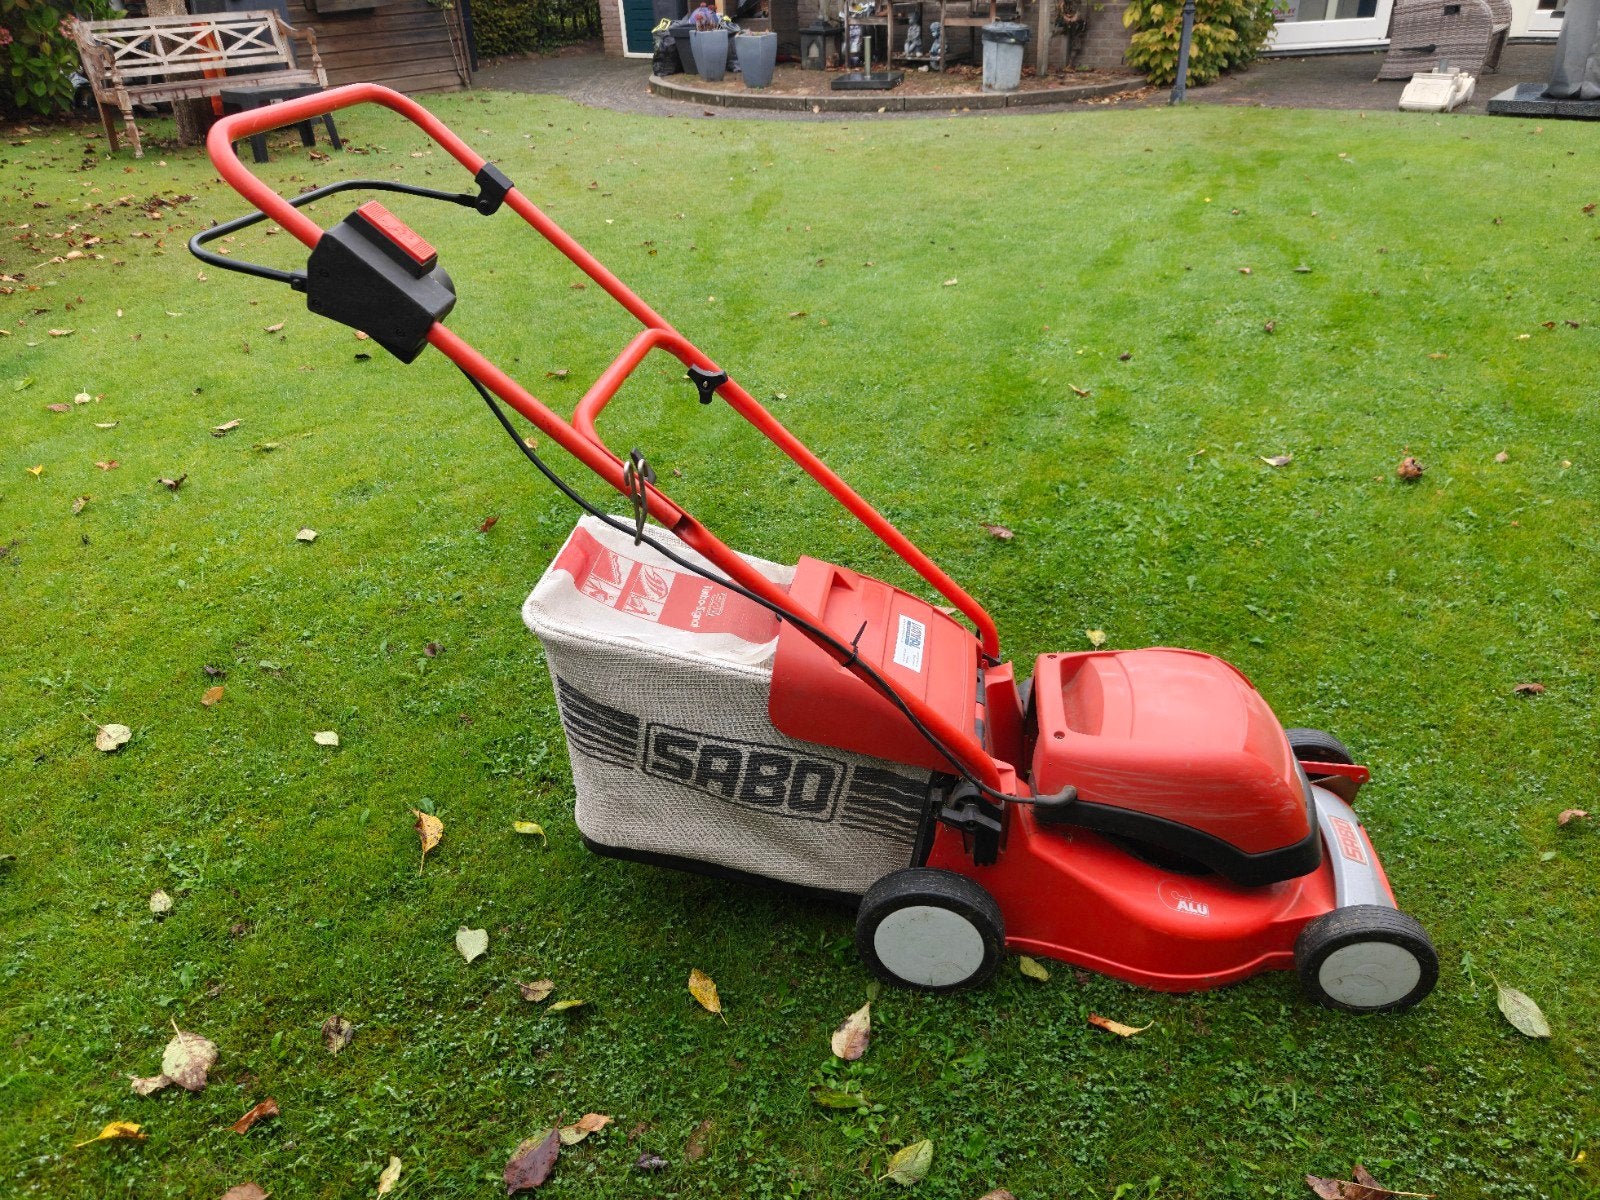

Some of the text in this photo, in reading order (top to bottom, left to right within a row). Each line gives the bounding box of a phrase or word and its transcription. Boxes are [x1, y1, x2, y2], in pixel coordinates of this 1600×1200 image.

[651, 732, 836, 813] SABO
[1331, 818, 1364, 861] SABO
[1176, 900, 1208, 916] ALU
